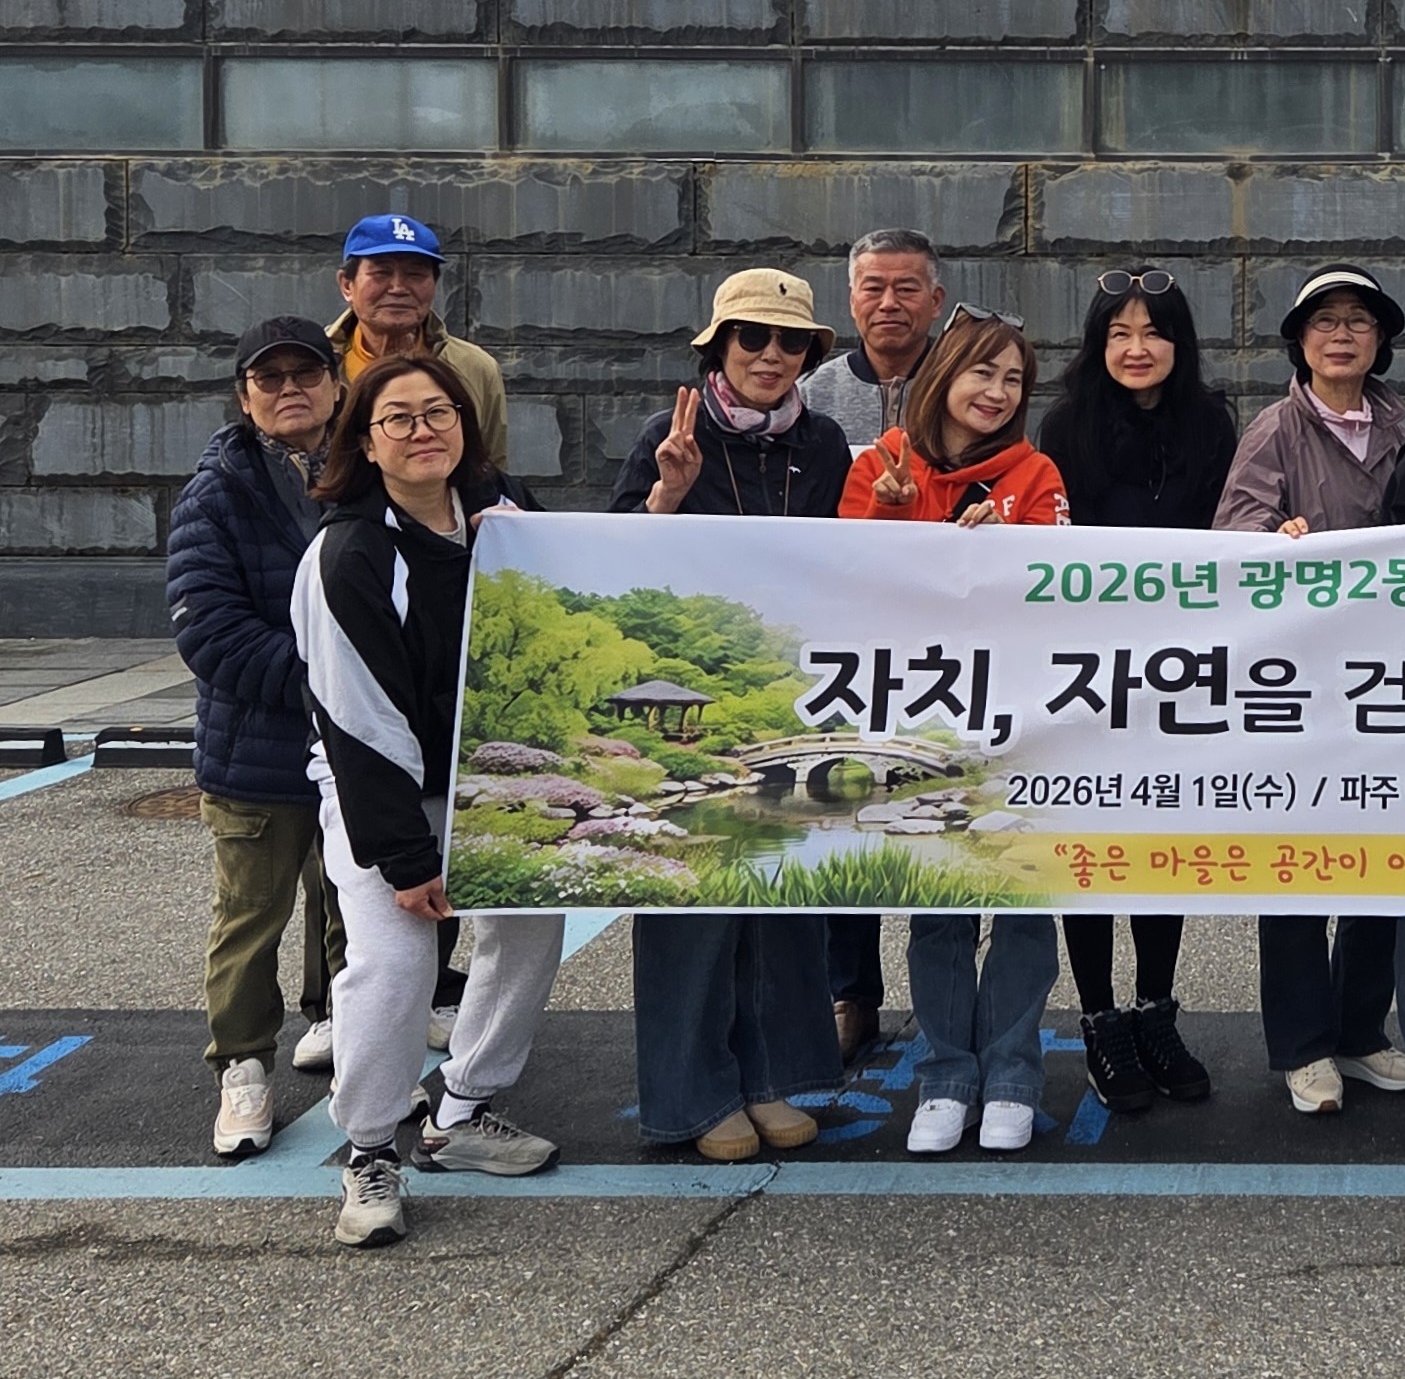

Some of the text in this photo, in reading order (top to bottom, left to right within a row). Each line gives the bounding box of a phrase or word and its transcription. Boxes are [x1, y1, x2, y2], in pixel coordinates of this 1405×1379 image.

[391, 218, 415, 241] LA
[1025, 561, 1219, 610] 2026년
[806, 644, 1013, 748] 자치,
[1045, 645, 1312, 735] 자연을
[1007, 773, 1123, 808] 2026년
[1130, 773, 1181, 809] 4월
[1192, 772, 1297, 812] 1일(수)
[1311, 776, 1328, 808] /
[1340, 774, 1400, 810] 파주
[1149, 845, 1251, 886] 마을은
[1270, 844, 1368, 884] 공간이
